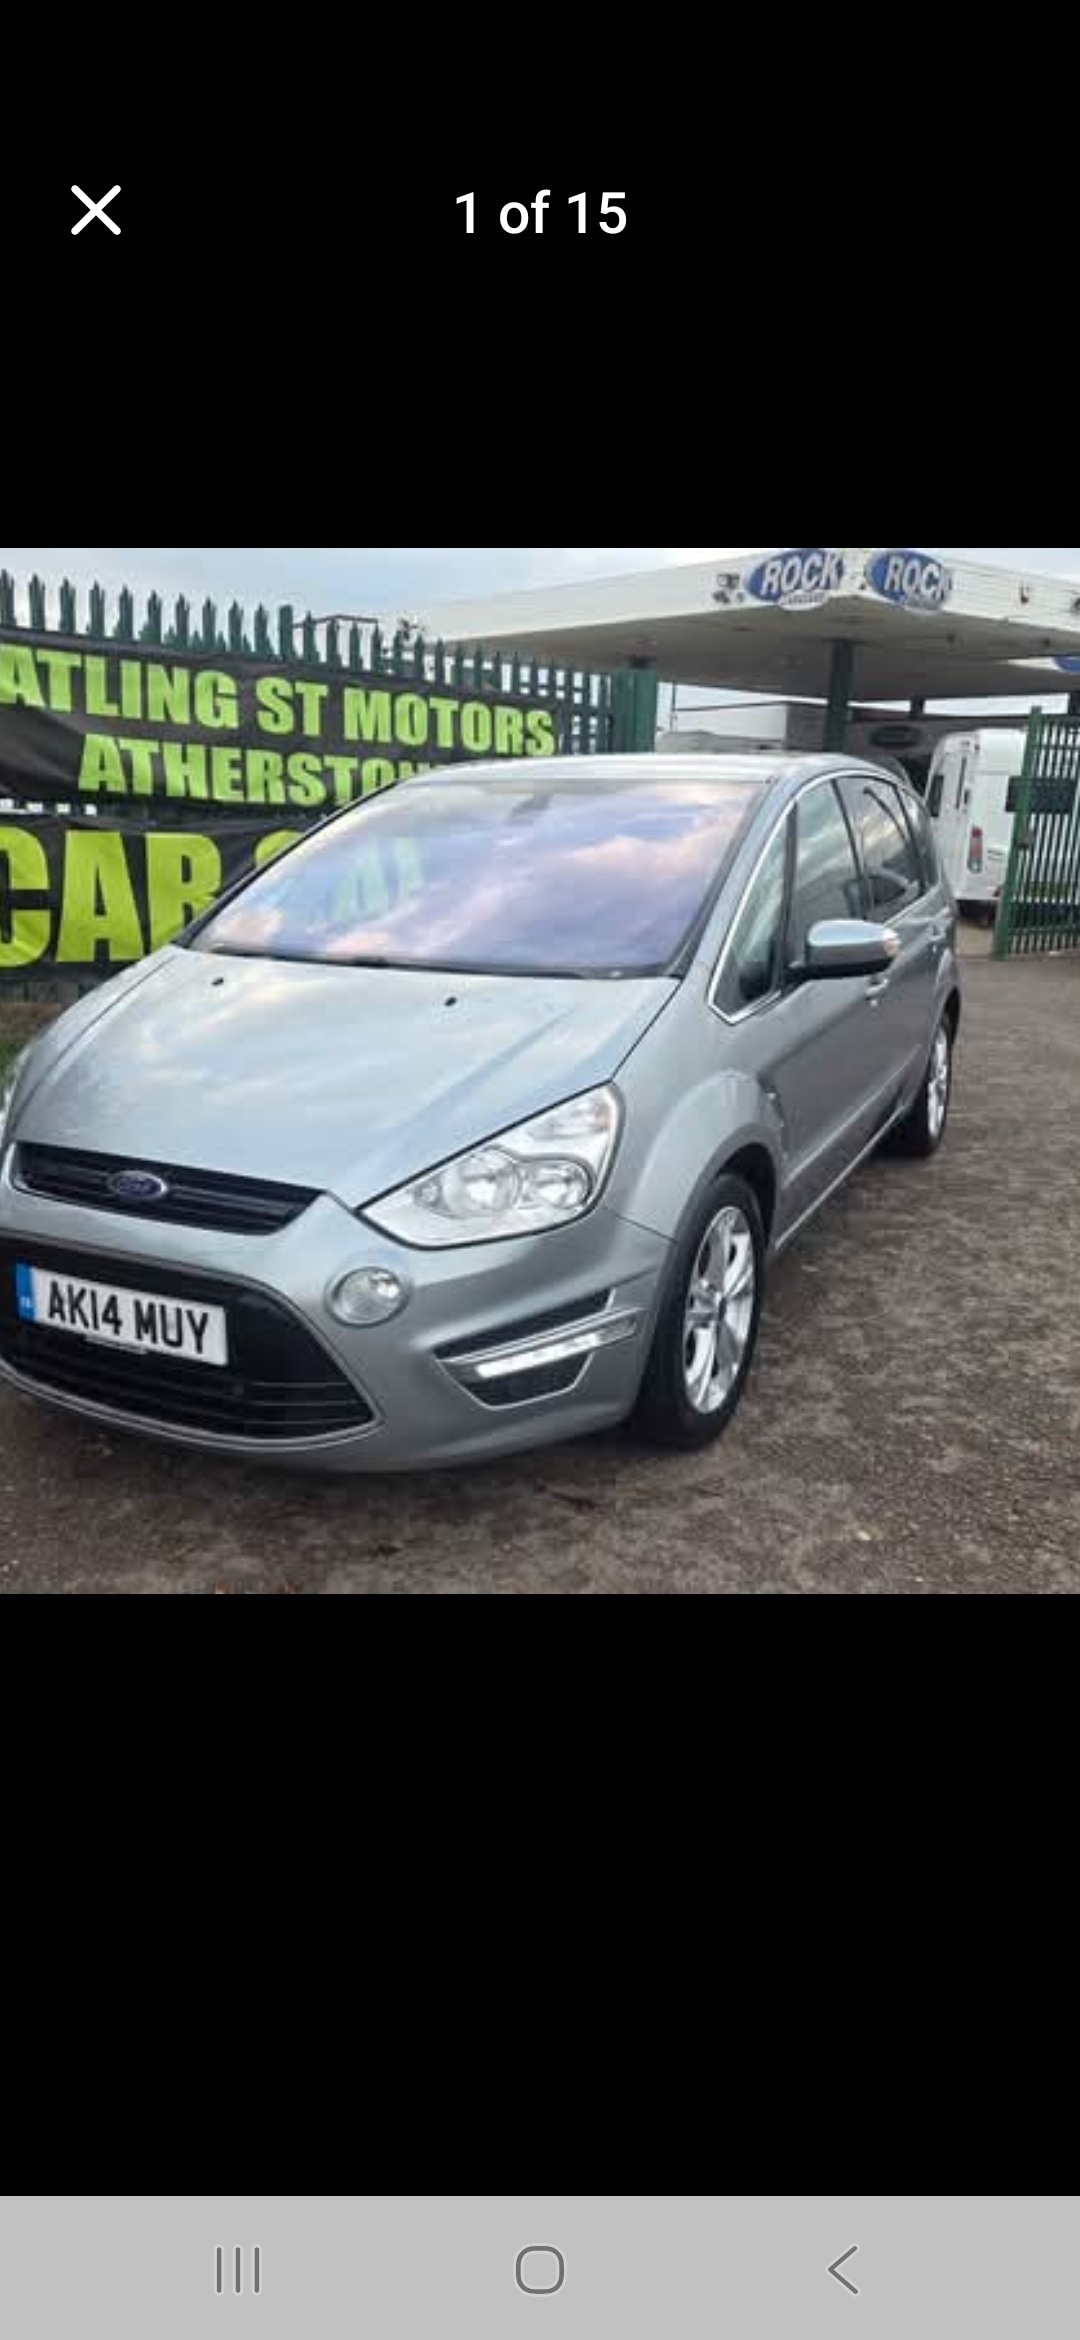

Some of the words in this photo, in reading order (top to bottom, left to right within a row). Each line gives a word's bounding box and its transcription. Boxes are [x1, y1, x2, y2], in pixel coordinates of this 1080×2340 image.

[760, 551, 841, 597] ROCK
[256, 677, 328, 738] ST
[344, 688, 556, 756] MOTORS
[48, 1280, 123, 1336] AK14
[134, 1299, 209, 1355] MUY
